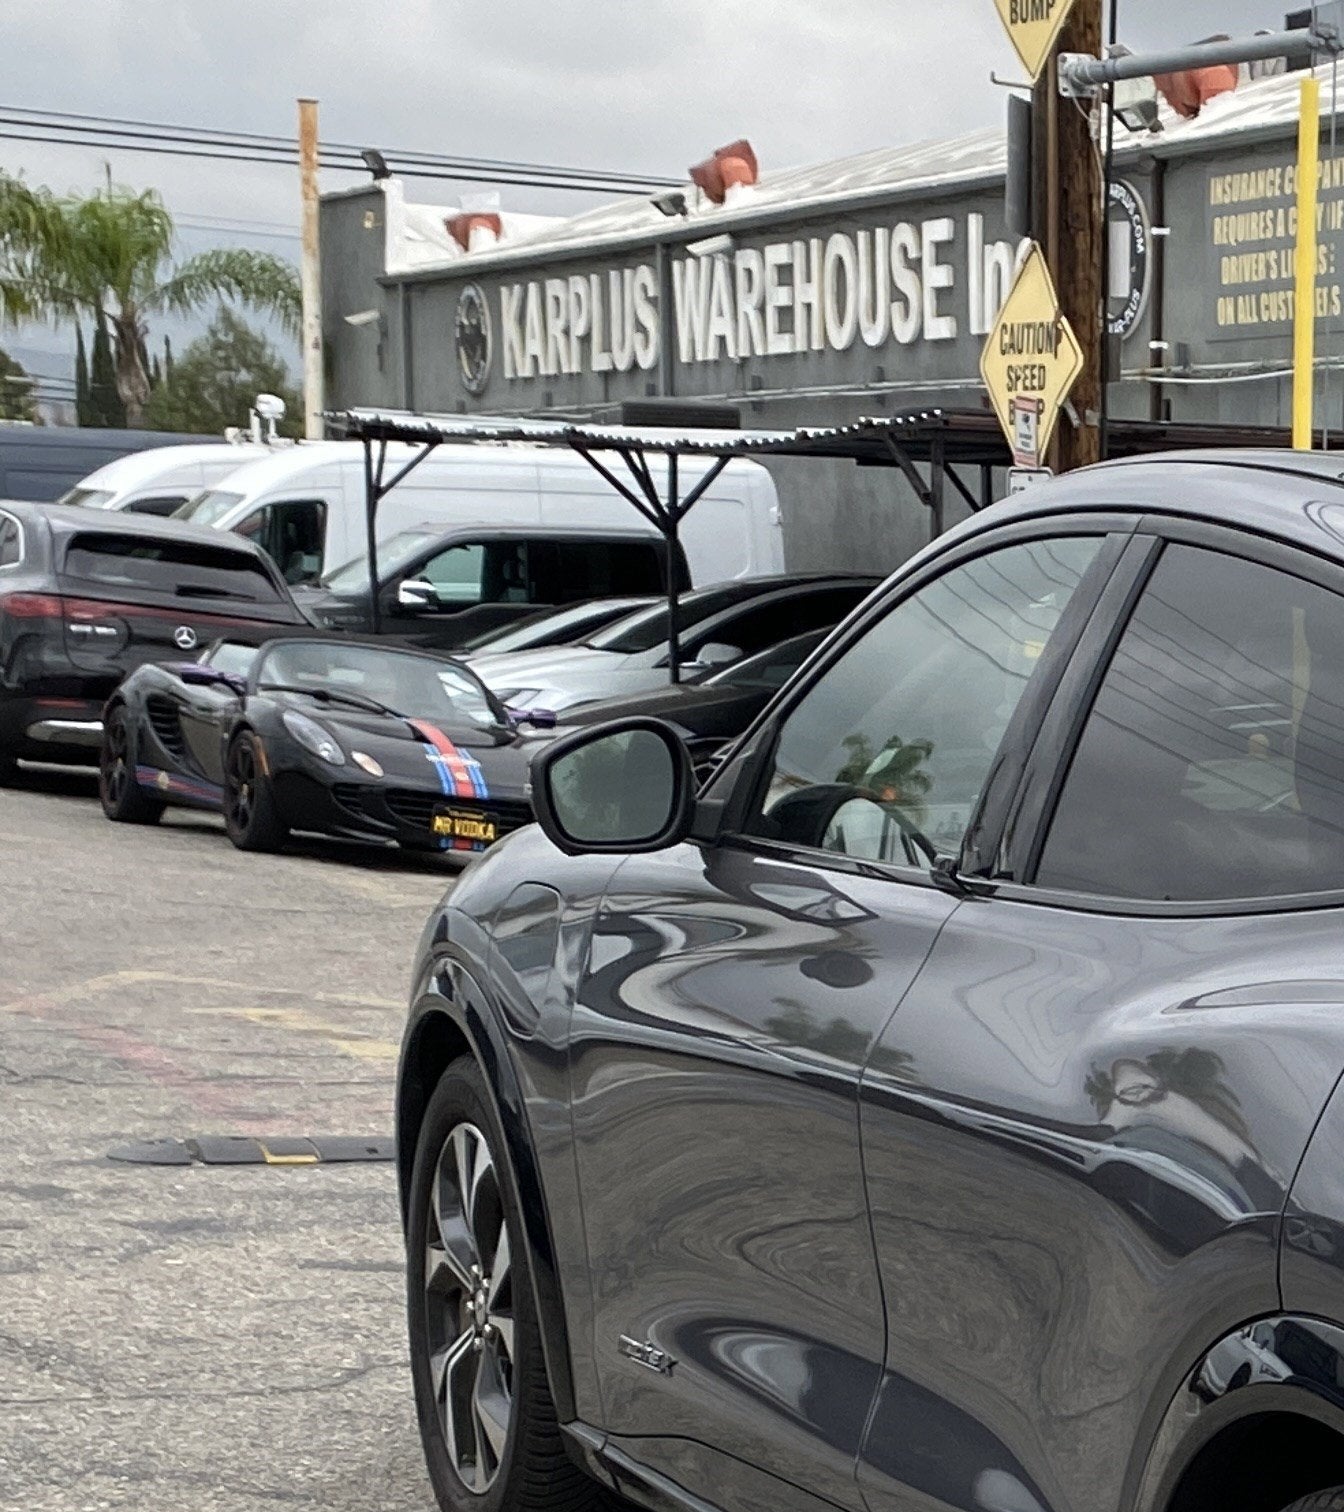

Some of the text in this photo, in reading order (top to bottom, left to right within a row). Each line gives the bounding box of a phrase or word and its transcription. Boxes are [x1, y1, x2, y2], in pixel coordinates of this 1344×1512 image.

[1010, 0, 1055, 24] BUMP
[1210, 167, 1282, 205] INSURANCE
[1213, 209, 1274, 246] REQUIRES
[1276, 208, 1285, 238] A
[1288, 201, 1324, 237] CY
[1221, 250, 1278, 285] DRIVER'S
[500, 264, 660, 379] KARPLUS
[672, 217, 957, 364] WAREHOUSE
[967, 213, 1032, 336] In
[1217, 297, 1236, 326] ON
[1237, 294, 1259, 324] ALL
[1000, 321, 1056, 356] CAUTION
[1006, 364, 1046, 392] SPEED
[1009, 398, 1045, 427] BP
